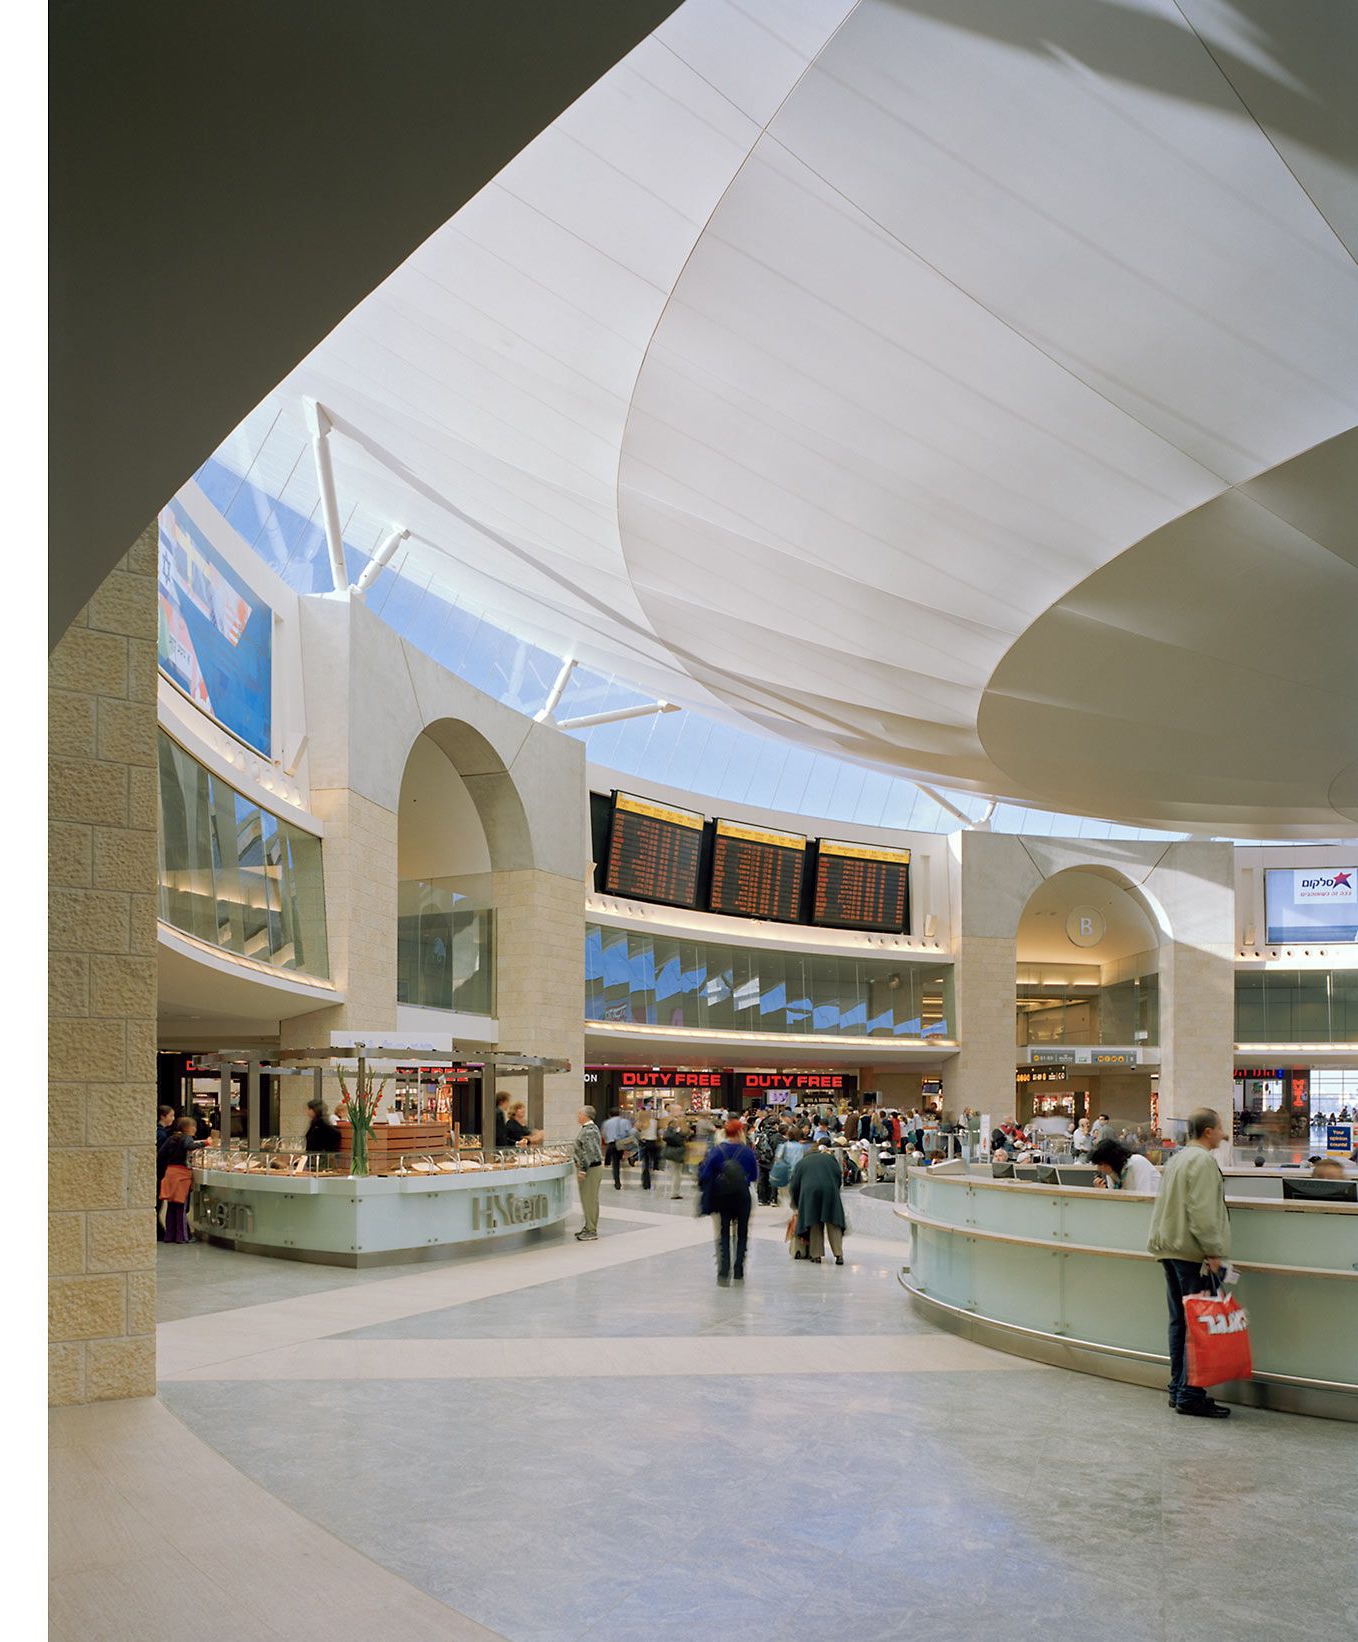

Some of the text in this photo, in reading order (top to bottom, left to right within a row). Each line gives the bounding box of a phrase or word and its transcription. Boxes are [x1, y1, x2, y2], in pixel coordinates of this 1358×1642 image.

[1302, 877, 1334, 889] סלקום
[1080, 917, 1092, 937] B
[623, 1072, 721, 1087] DUTY FREE
[746, 1074, 843, 1088] DUTY FREE
